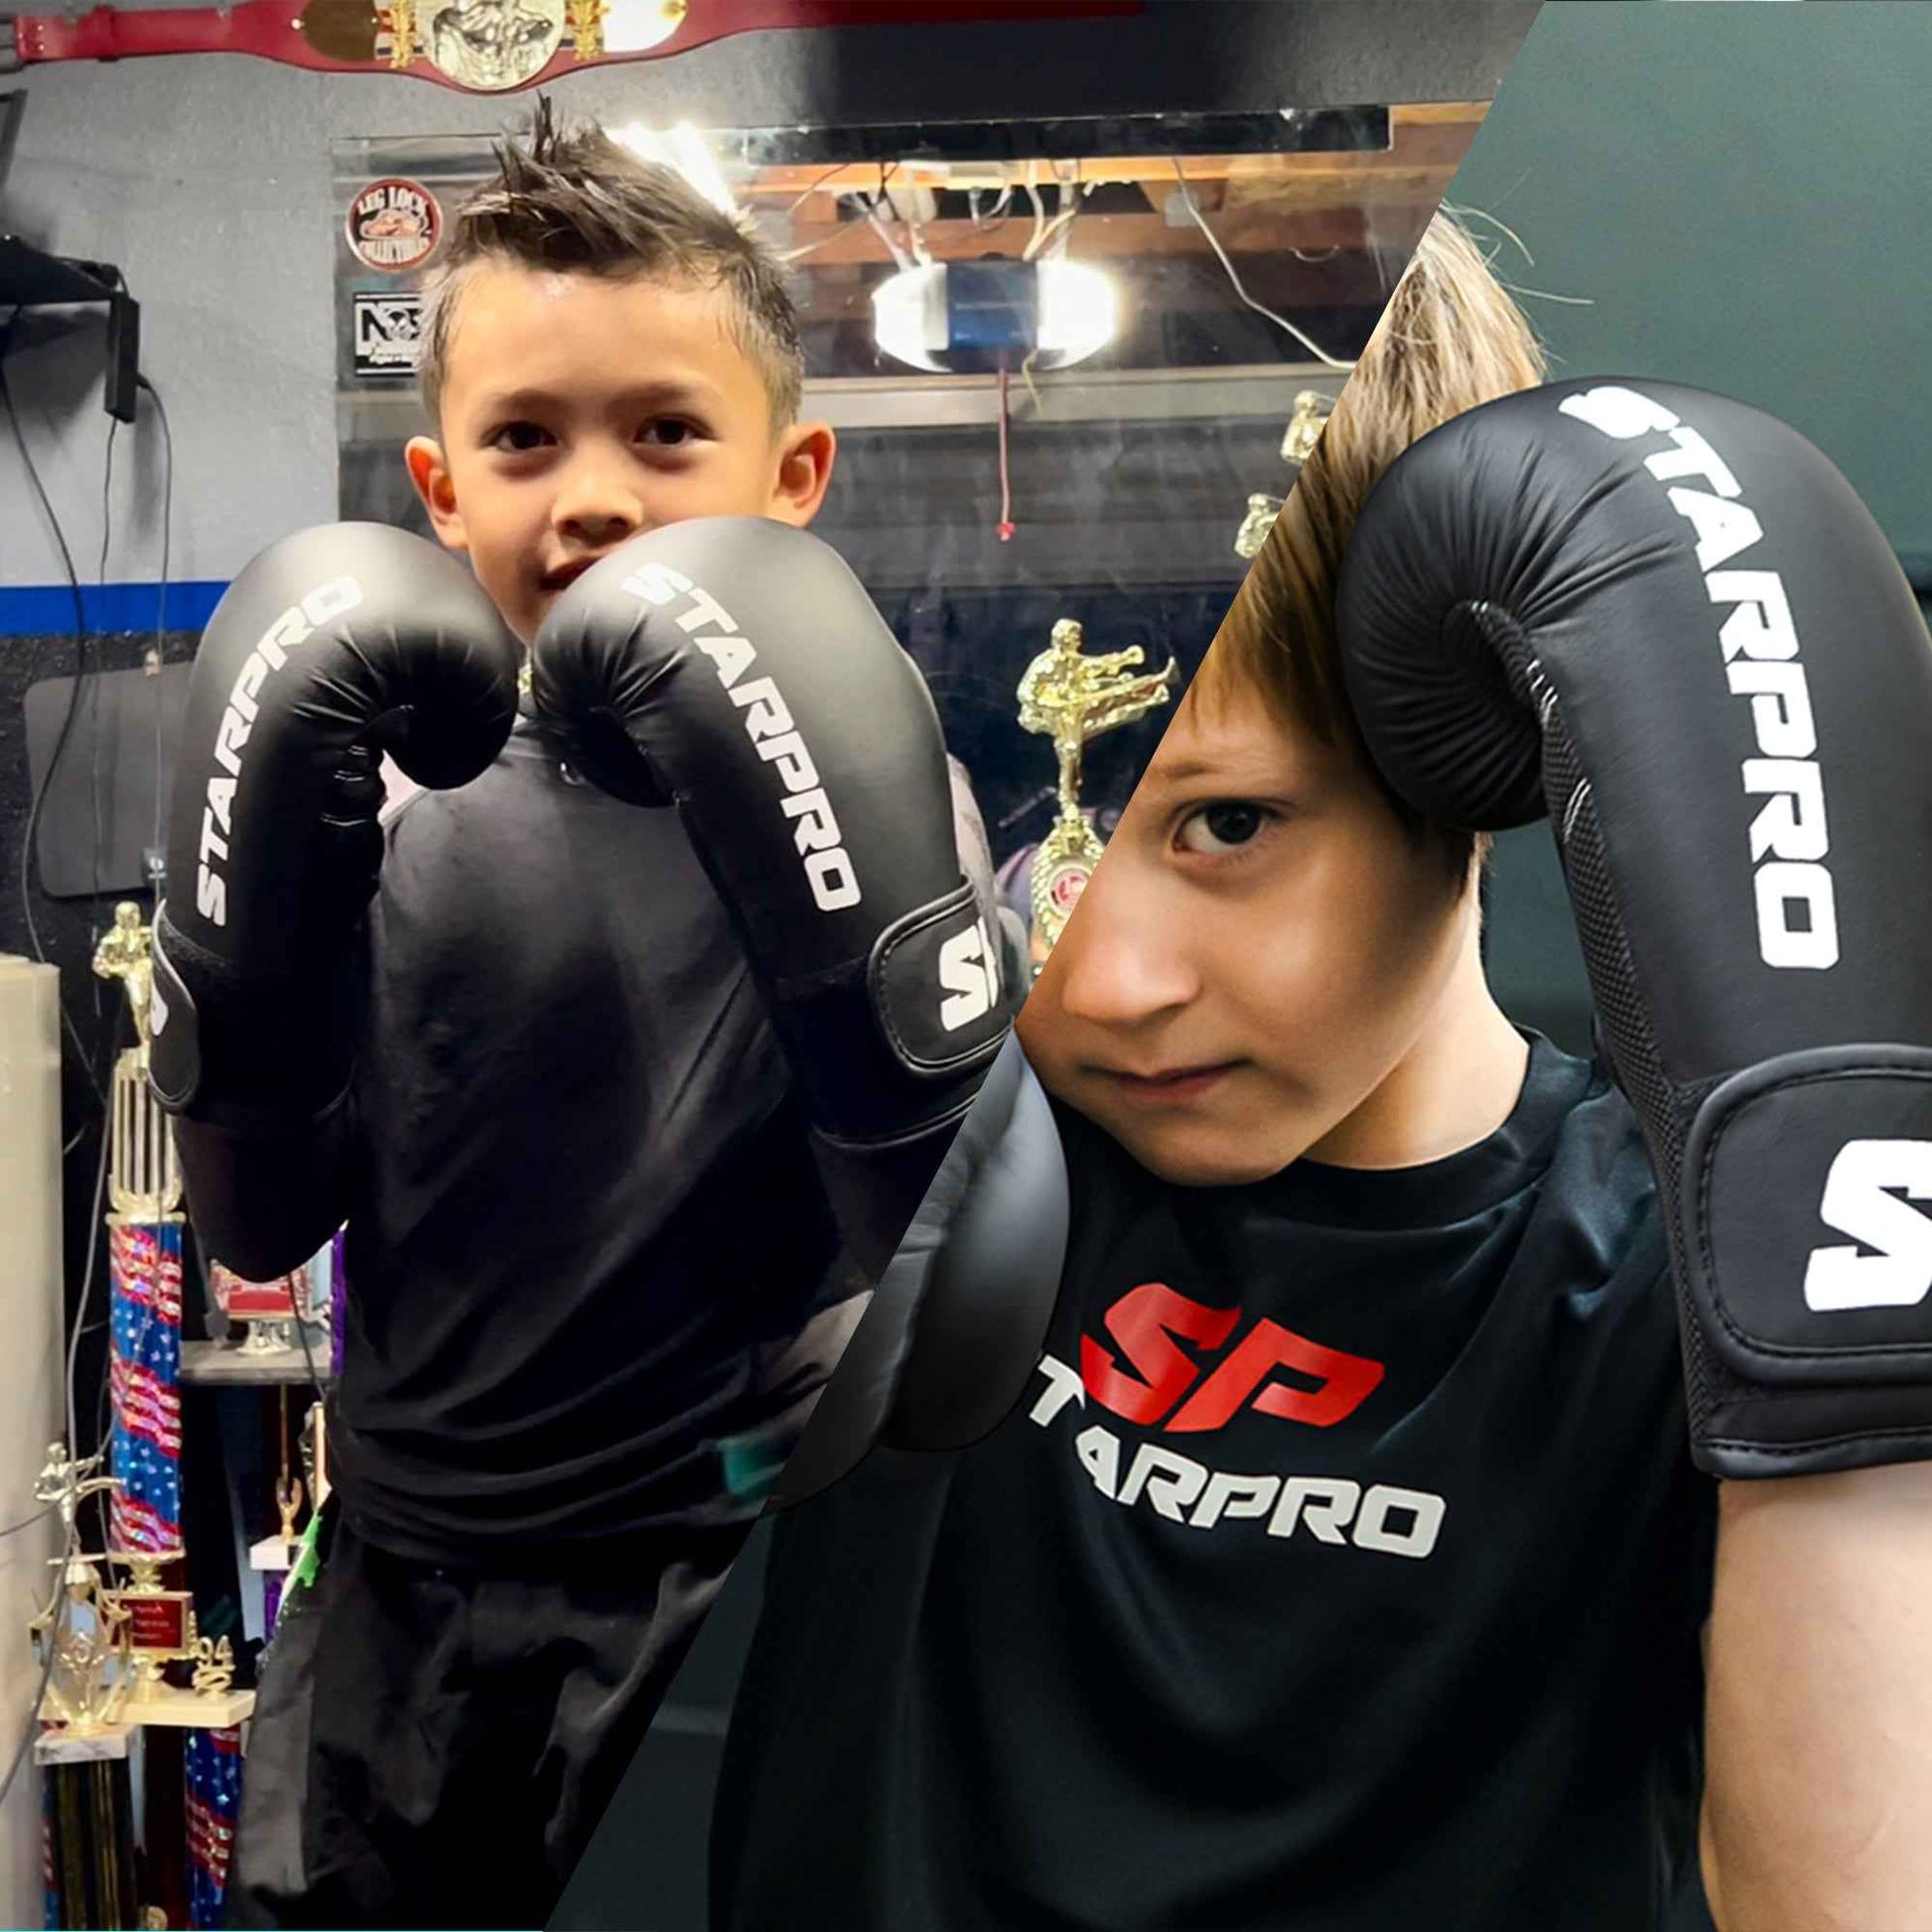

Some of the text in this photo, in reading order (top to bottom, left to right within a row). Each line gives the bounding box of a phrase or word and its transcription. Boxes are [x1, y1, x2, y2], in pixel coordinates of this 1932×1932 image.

[197, 575, 363, 927] STARPRO
[621, 562, 862, 911] STARPRO
[1559, 385, 1840, 969] STARPRO
[1080, 1282, 1386, 1433] SP
